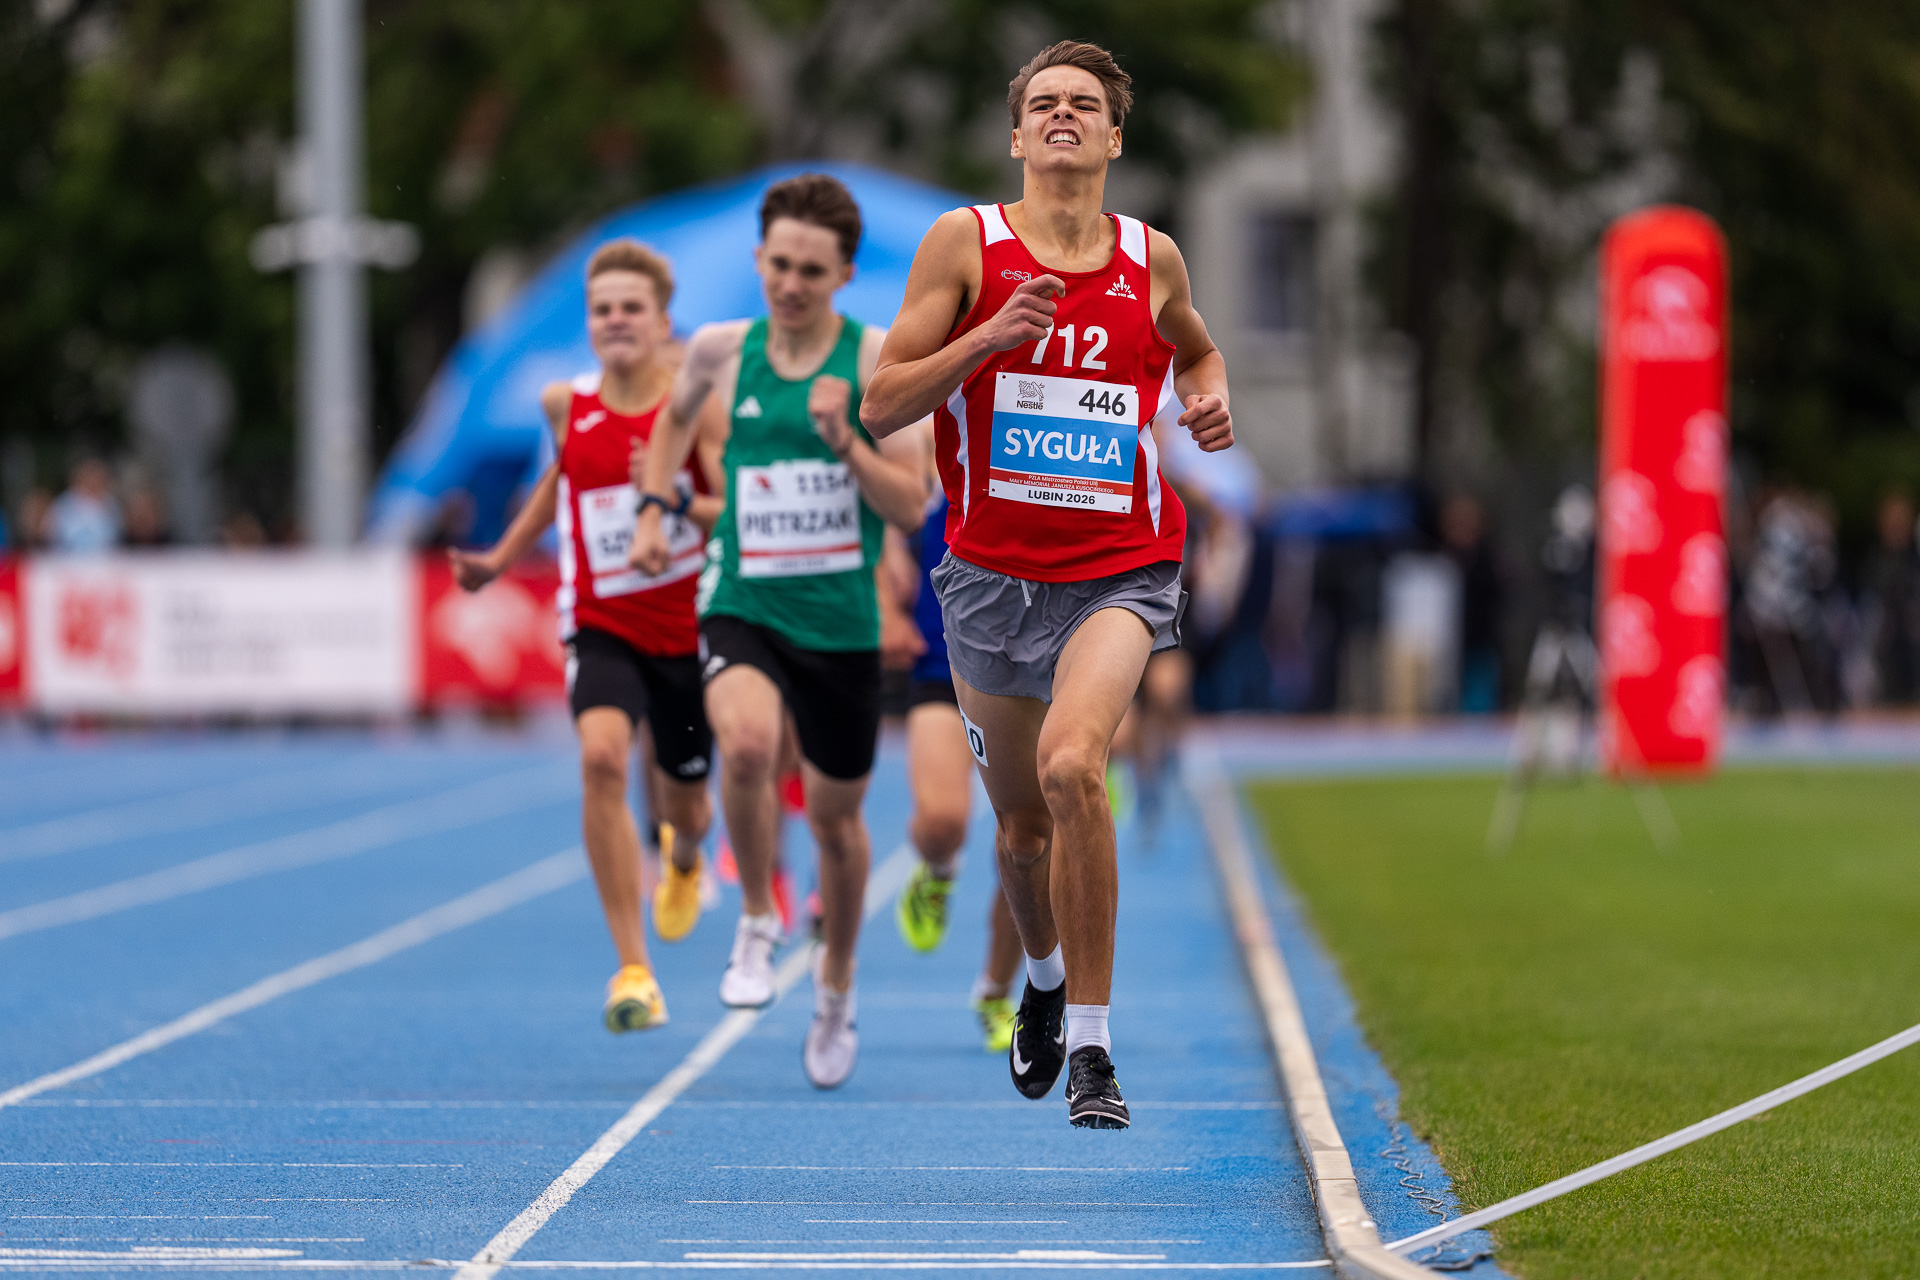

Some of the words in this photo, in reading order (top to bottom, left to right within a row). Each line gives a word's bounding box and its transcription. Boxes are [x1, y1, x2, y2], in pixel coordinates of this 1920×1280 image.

[1031, 322, 1108, 371] 712
[1079, 389, 1126, 417] 446
[1003, 427, 1123, 467] SYGUŁA
[1028, 489, 1064, 502] LUBIN
[1066, 493, 1096, 505] 2026
